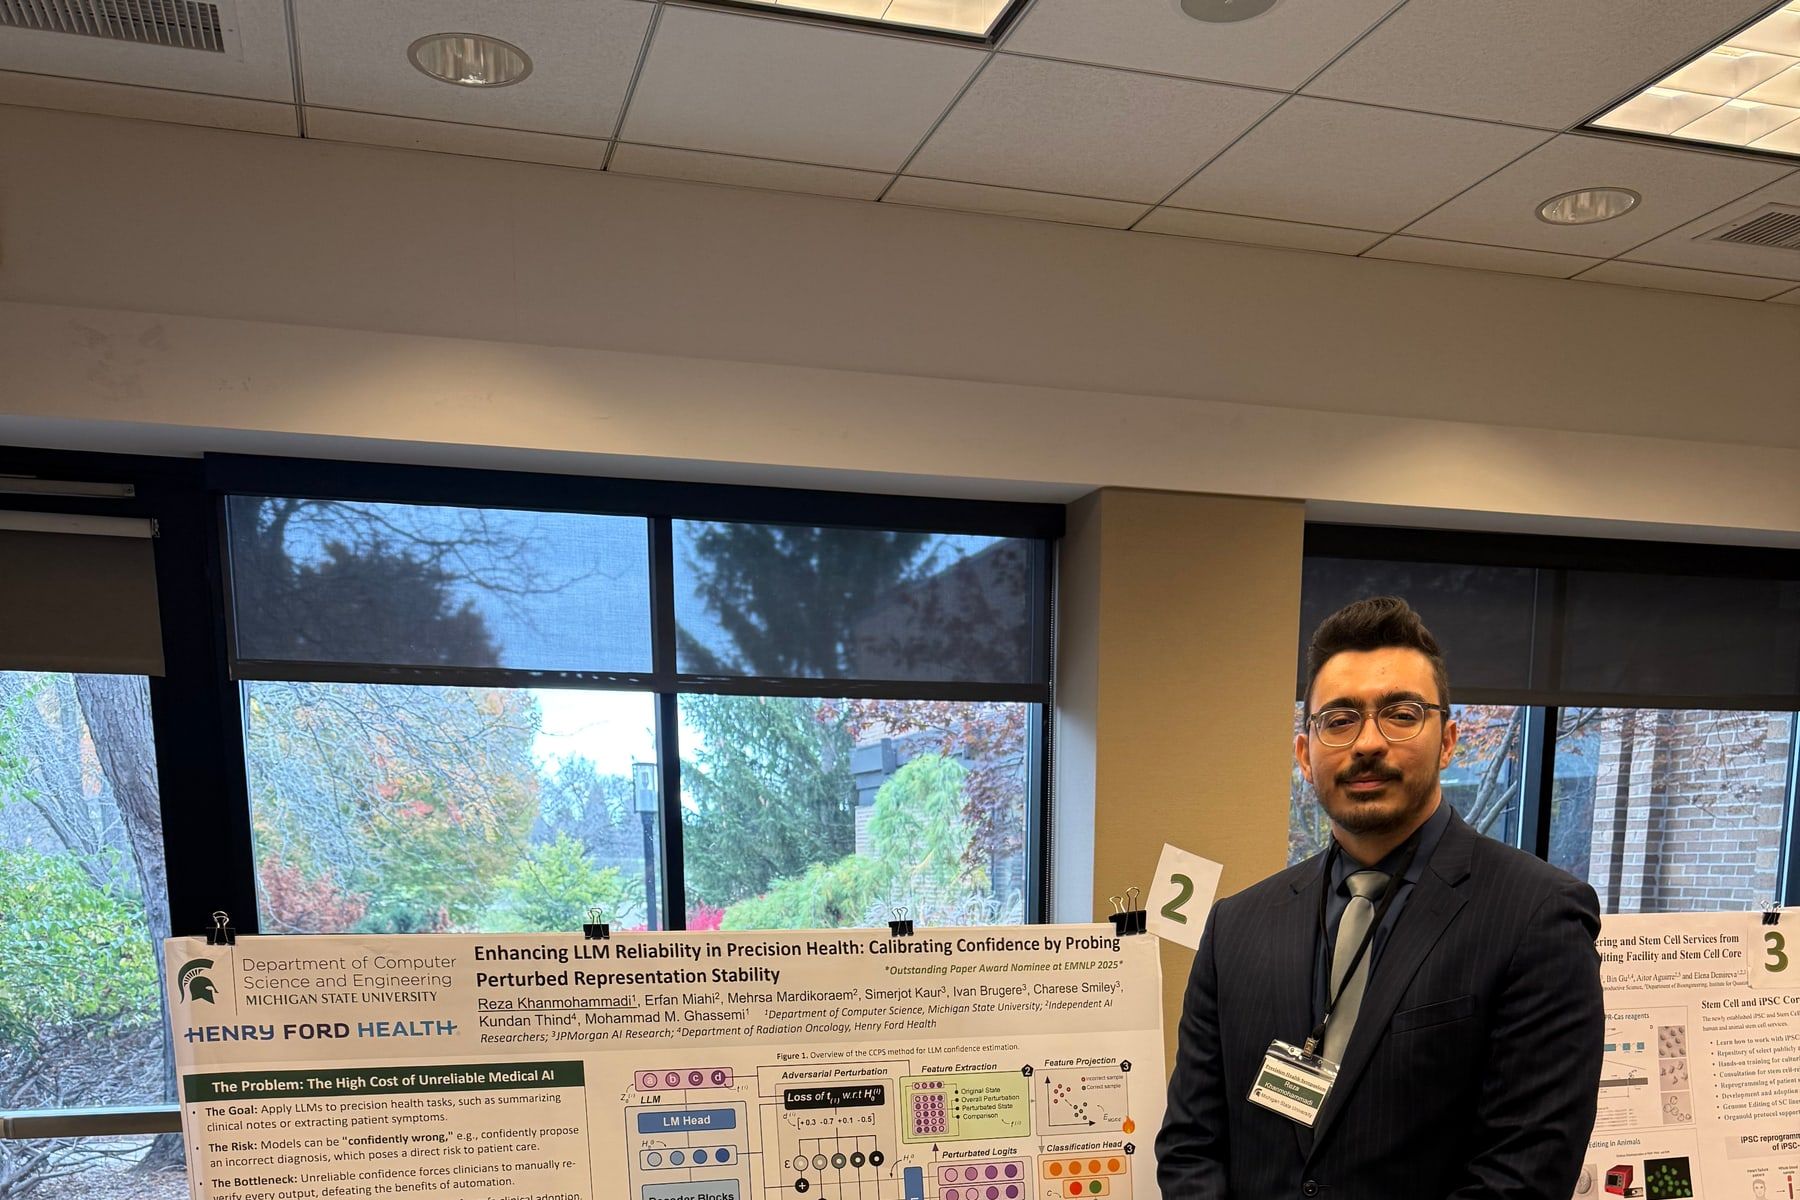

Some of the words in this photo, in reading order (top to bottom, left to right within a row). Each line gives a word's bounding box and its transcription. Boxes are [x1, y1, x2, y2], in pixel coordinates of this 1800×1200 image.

[1161, 874, 1194, 924] 2
[1619, 935, 1636, 945] and
[1638, 935, 1660, 945] Stem
[1663, 934, 1680, 944] Cell
[1682, 934, 1717, 944] Services
[1719, 933, 1739, 943] from
[474, 944, 568, 963] Enhancing
[574, 944, 609, 959] LLM
[615, 942, 701, 961] Reliability
[706, 942, 721, 957] in
[727, 941, 801, 956] Precision
[806, 939, 863, 955] Health:
[869, 938, 952, 955] Calibrating
[956, 937, 1039, 952] Confidence
[1044, 936, 1061, 953] by
[1065, 935, 1120, 952] Probing
[1626, 950, 1659, 962] Facility
[1661, 950, 1677, 959] and
[1679, 949, 1700, 959] Stem
[1703, 948, 1719, 958] Cell
[1721, 948, 1741, 958] Core
[1764, 931, 1788, 972] 3
[242, 957, 346, 973] Department
[351, 955, 368, 969] of
[373, 955, 456, 970] Computer
[949, 964, 976, 974] Paper
[978, 963, 1008, 972] Award
[1010, 962, 1050, 971] Nominee
[1052, 962, 1061, 970] at
[1064, 960, 1095, 970] EMNLP
[243, 975, 309, 989] Science
[315, 973, 346, 987] and
[352, 972, 451, 988] Engineering
[476, 970, 568, 987] Perturbed
[574, 968, 706, 988] Representation
[711, 966, 779, 984] Stability
[246, 993, 317, 1005] MICHIGAN
[321, 992, 358, 1003] STATE
[361, 991, 436, 1002] UNIVERSITY
[478, 998, 514, 1010] Reza
[644, 993, 678, 1005] Erfan
[727, 992, 772, 1003] Mehrsa
[865, 987, 911, 1001] Simerjot
[953, 986, 976, 996] Ivan
[1033, 983, 1078, 994] Charese
[1701, 1000, 1720, 1009] Stem
[1722, 998, 1739, 1008] Cell
[1741, 997, 1756, 1006] and
[1758, 996, 1780, 1005] iPSC
[183, 1024, 274, 1042] HENRY
[283, 1022, 349, 1039] FORD
[357, 1020, 459, 1037] HEALTH
[954, 1062, 997, 1071] Extraction
[1075, 1056, 1115, 1066] Projection
[781, 1069, 832, 1079] Adversarial
[833, 1067, 887, 1076] Perturbation
[211, 1081, 237, 1092] The
[241, 1078, 303, 1091] Problem:
[306, 1077, 332, 1089] The
[335, 1076, 366, 1090] High
[369, 1076, 398, 1086] Cost
[401, 1073, 415, 1085] of
[418, 1072, 485, 1085] Unreliable
[488, 1069, 538, 1082] Medical
[541, 1069, 554, 1080] AI
[640, 1095, 660, 1104] LLM
[663, 1116, 679, 1126] LM
[682, 1114, 710, 1125] Head
[1046, 1142, 1100, 1151] Classification
[1100, 1139, 1122, 1149] Head
[1740, 1135, 1758, 1143] iPSC
[941, 1148, 990, 1158] Perturbated
[992, 1146, 1017, 1156] Logits
